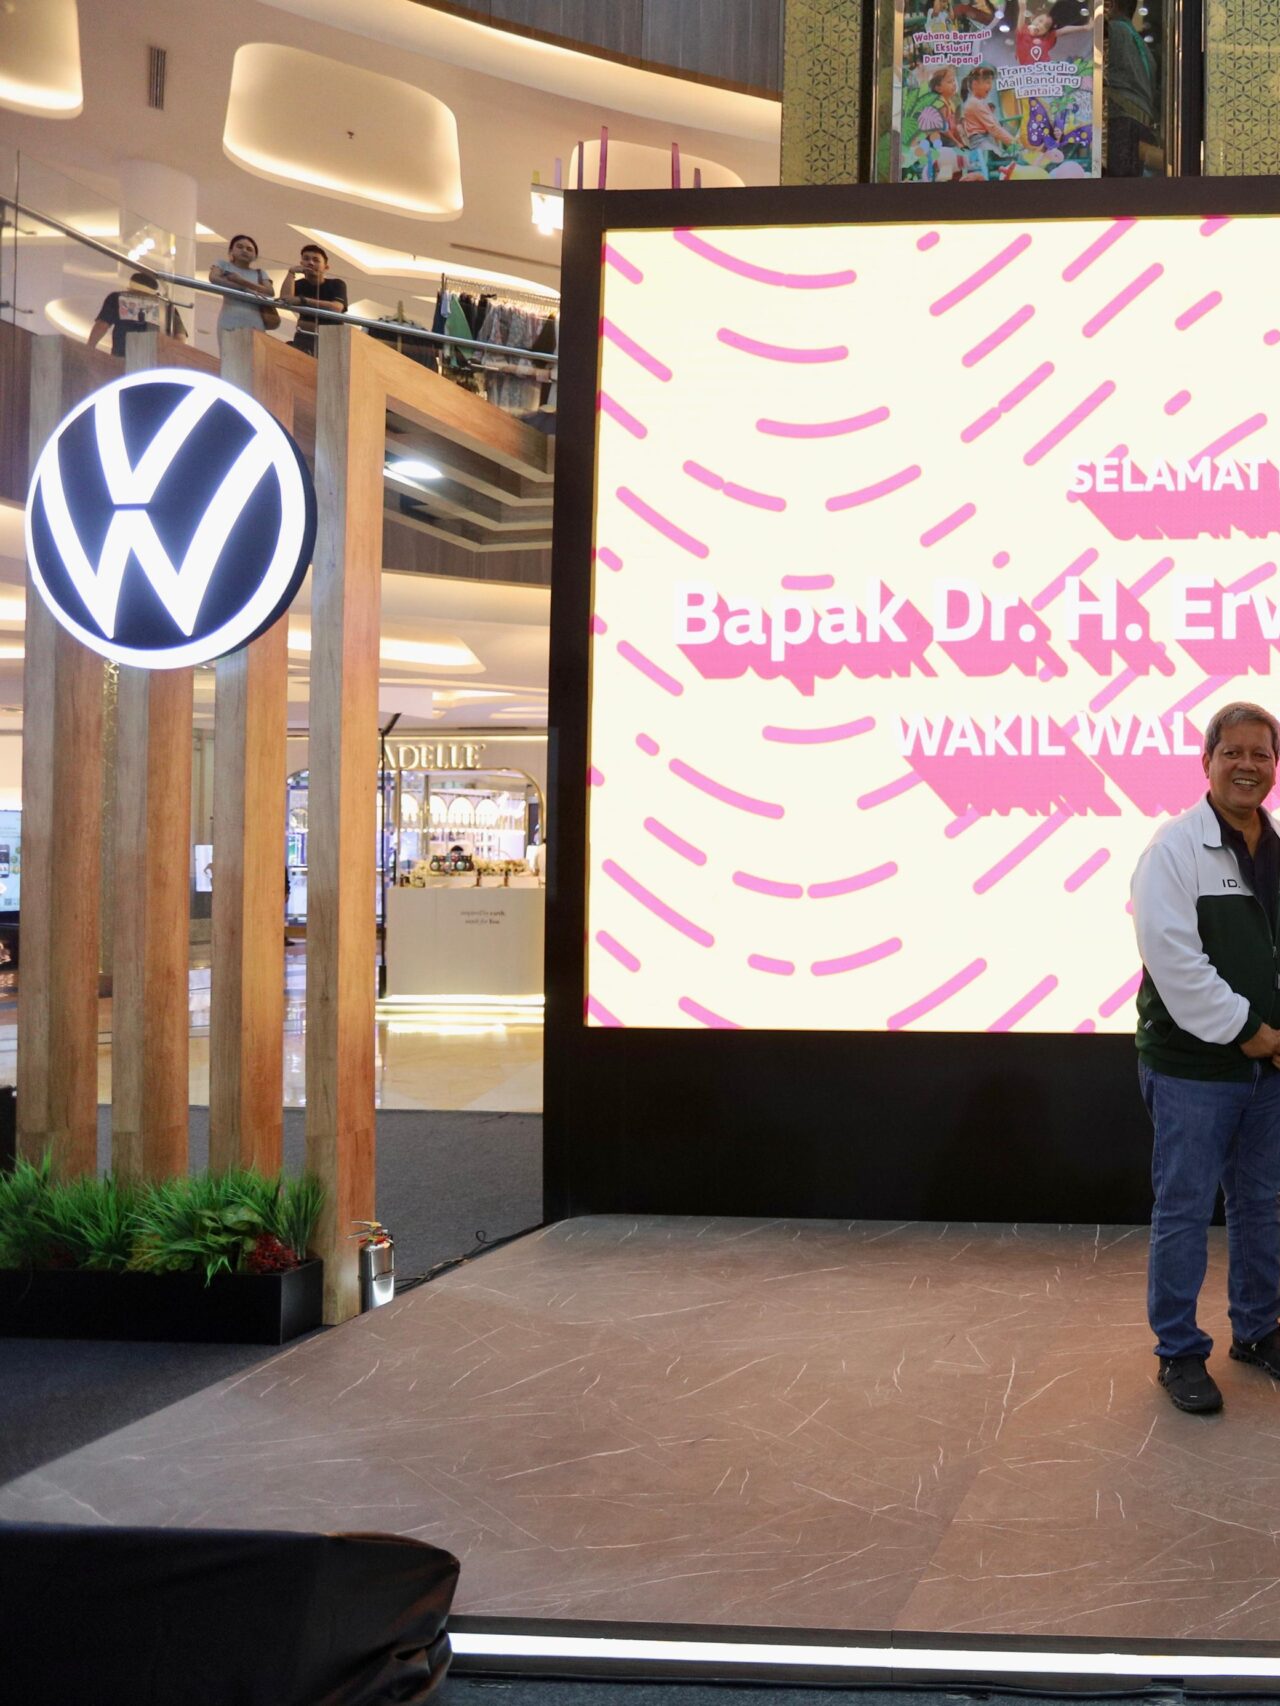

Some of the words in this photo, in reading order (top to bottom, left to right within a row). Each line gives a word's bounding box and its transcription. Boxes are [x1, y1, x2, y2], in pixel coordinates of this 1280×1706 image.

[914, 32, 950, 42] Wahana
[952, 31, 991, 40] Bermain
[935, 44, 970, 52] Ekslusif
[946, 55, 982, 65] Jepang!
[1000, 65, 1033, 76] Trans
[1035, 62, 1076, 72] Studio
[998, 76, 1023, 88] Mall
[1025, 75, 1079, 86] Bandung
[1017, 86, 1051, 96] Lantai
[1053, 86, 1061, 95] 2
[1069, 456, 1266, 492] SELAMAT
[673, 576, 907, 661] Bapak
[932, 576, 1036, 642] Dr.
[1064, 576, 1142, 641] H.
[891, 710, 1066, 756] WAKIL
[1077, 710, 1200, 756] WAL
[1222, 878, 1241, 889] ID.
